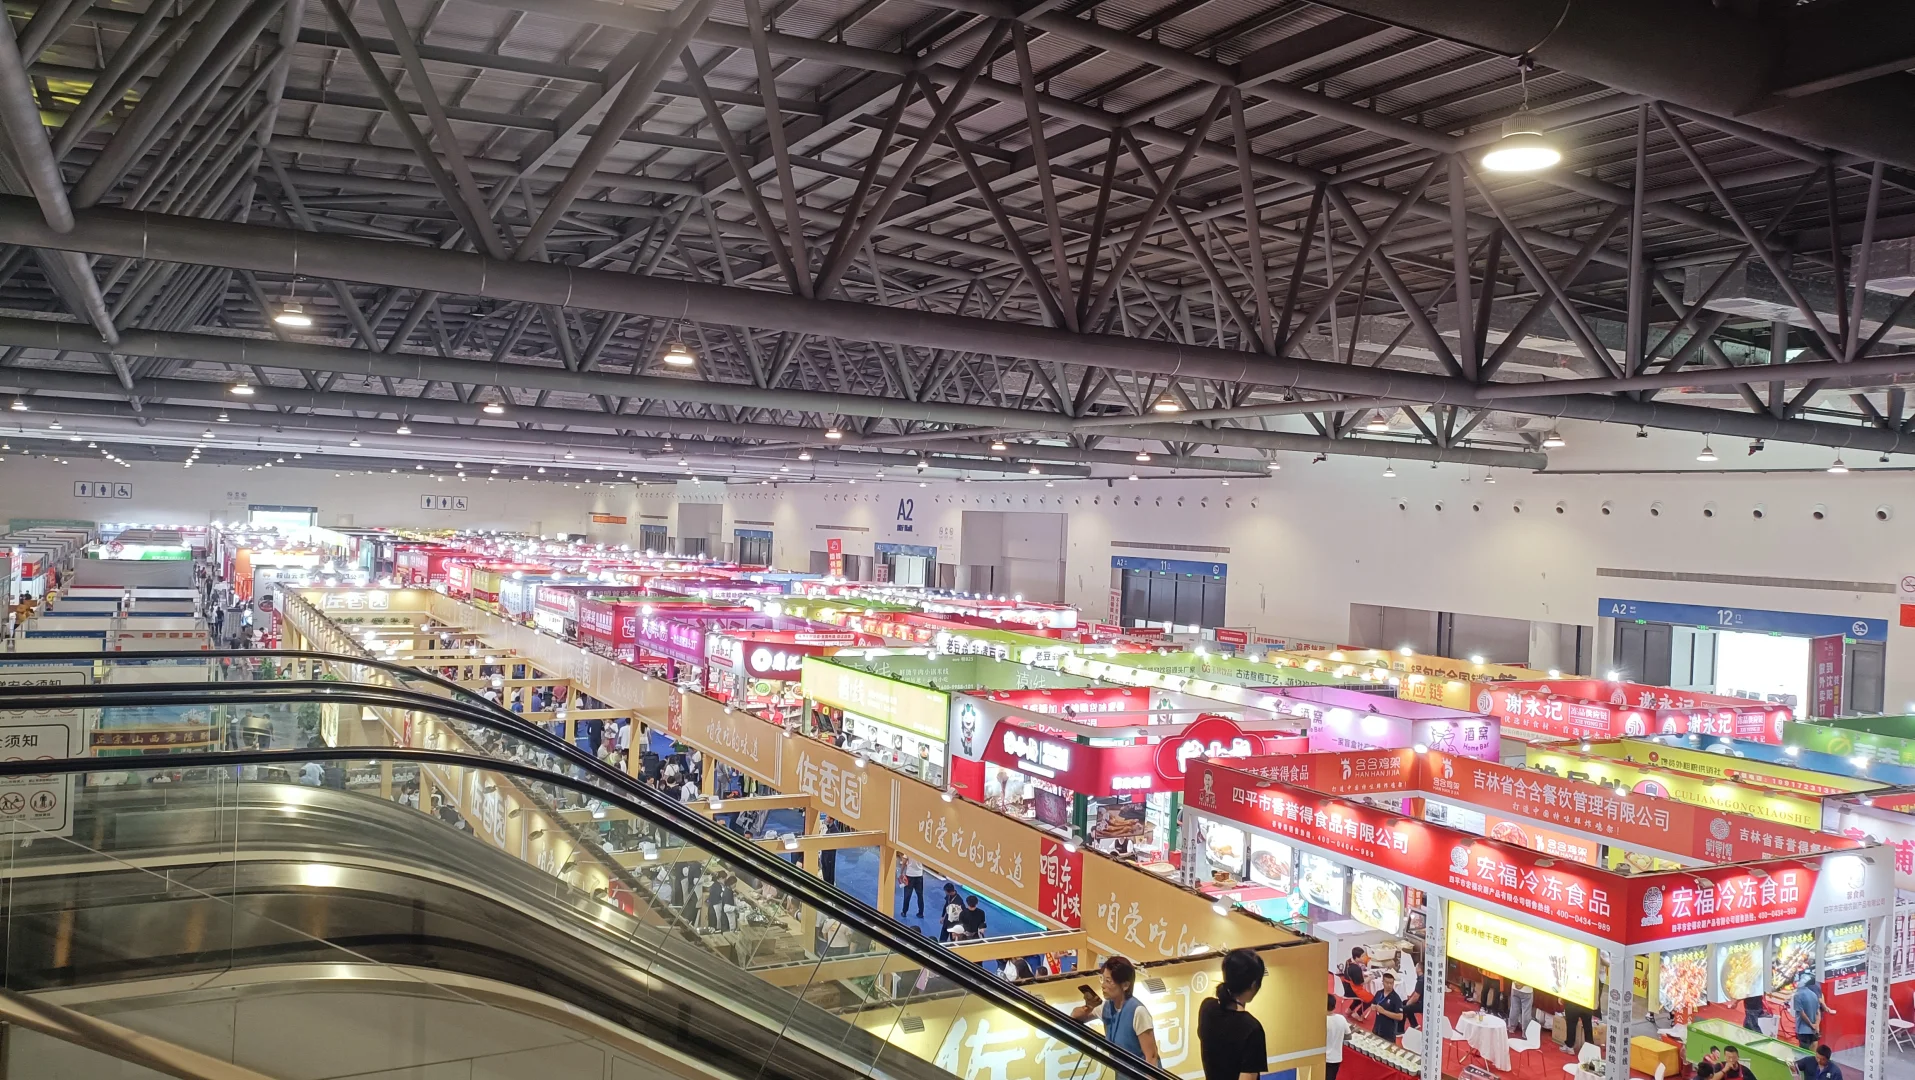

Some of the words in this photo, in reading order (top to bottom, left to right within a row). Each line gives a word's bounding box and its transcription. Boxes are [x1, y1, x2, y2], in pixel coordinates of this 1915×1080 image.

[896, 498, 914, 521] A2
[1117, 559, 1124, 567] A2
[1160, 561, 1167, 571] 11
[319, 591, 390, 610] 佐香园
[1611, 603, 1627, 615] A2
[1717, 610, 1733, 626] 12
[1504, 693, 1564, 721] 谢永记
[1638, 691, 1695, 710] 谢永记
[1687, 713, 1733, 733] 谢永记
[1464, 726, 1489, 742] 酒窝
[1463, 742, 1478, 751] Home
[1479, 742, 1490, 751] Bar
[1356, 757, 1401, 771] 含含鸡架
[796, 750, 862, 820] 佐香园
[1473, 769, 1670, 832] 吉林省含含餐饮管理有限公司
[1674, 789, 1812, 825] CULIANGGONGXIAOSHE
[1232, 787, 1410, 855] 四平市香誉得食品有限公司
[918, 811, 1025, 888] 咱爱吃的味道
[1547, 838, 1588, 857] 含含鸡架
[1476, 856, 1611, 917] 宏福冷冻食品
[1671, 872, 1799, 918] 宏福冷冻食品
